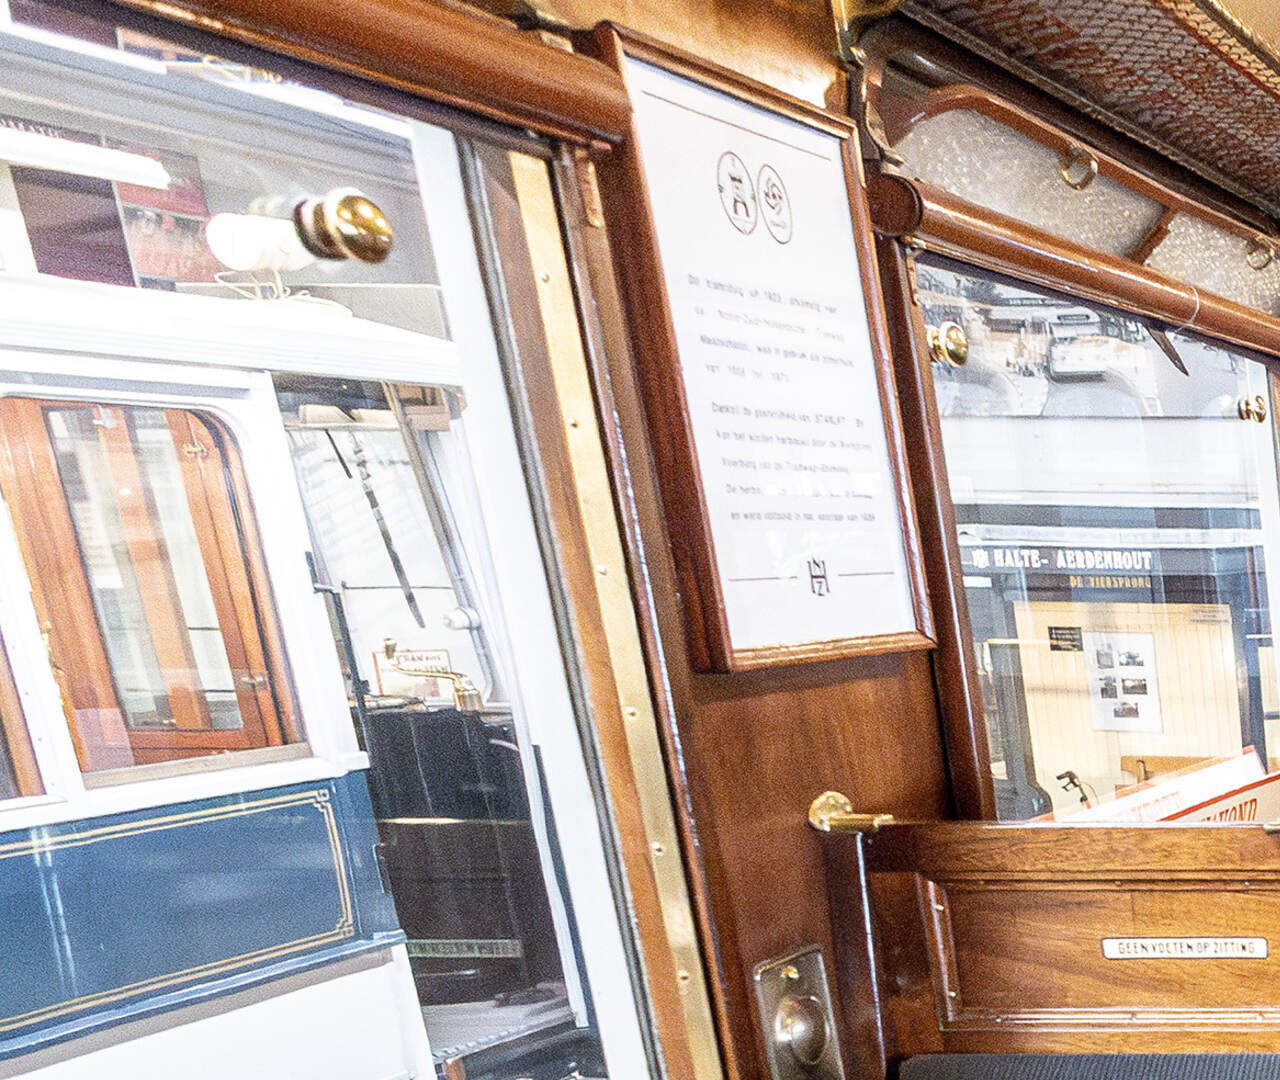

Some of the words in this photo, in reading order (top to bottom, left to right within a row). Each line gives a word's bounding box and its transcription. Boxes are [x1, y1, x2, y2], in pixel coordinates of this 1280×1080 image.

[1056, 549, 1152, 569] AERDENHOUT
[1118, 942, 1148, 954] GEEN
[1151, 942, 1193, 954] VOETEN
[1197, 942, 1210, 953] OP
[1213, 941, 1255, 954] ZITTING
